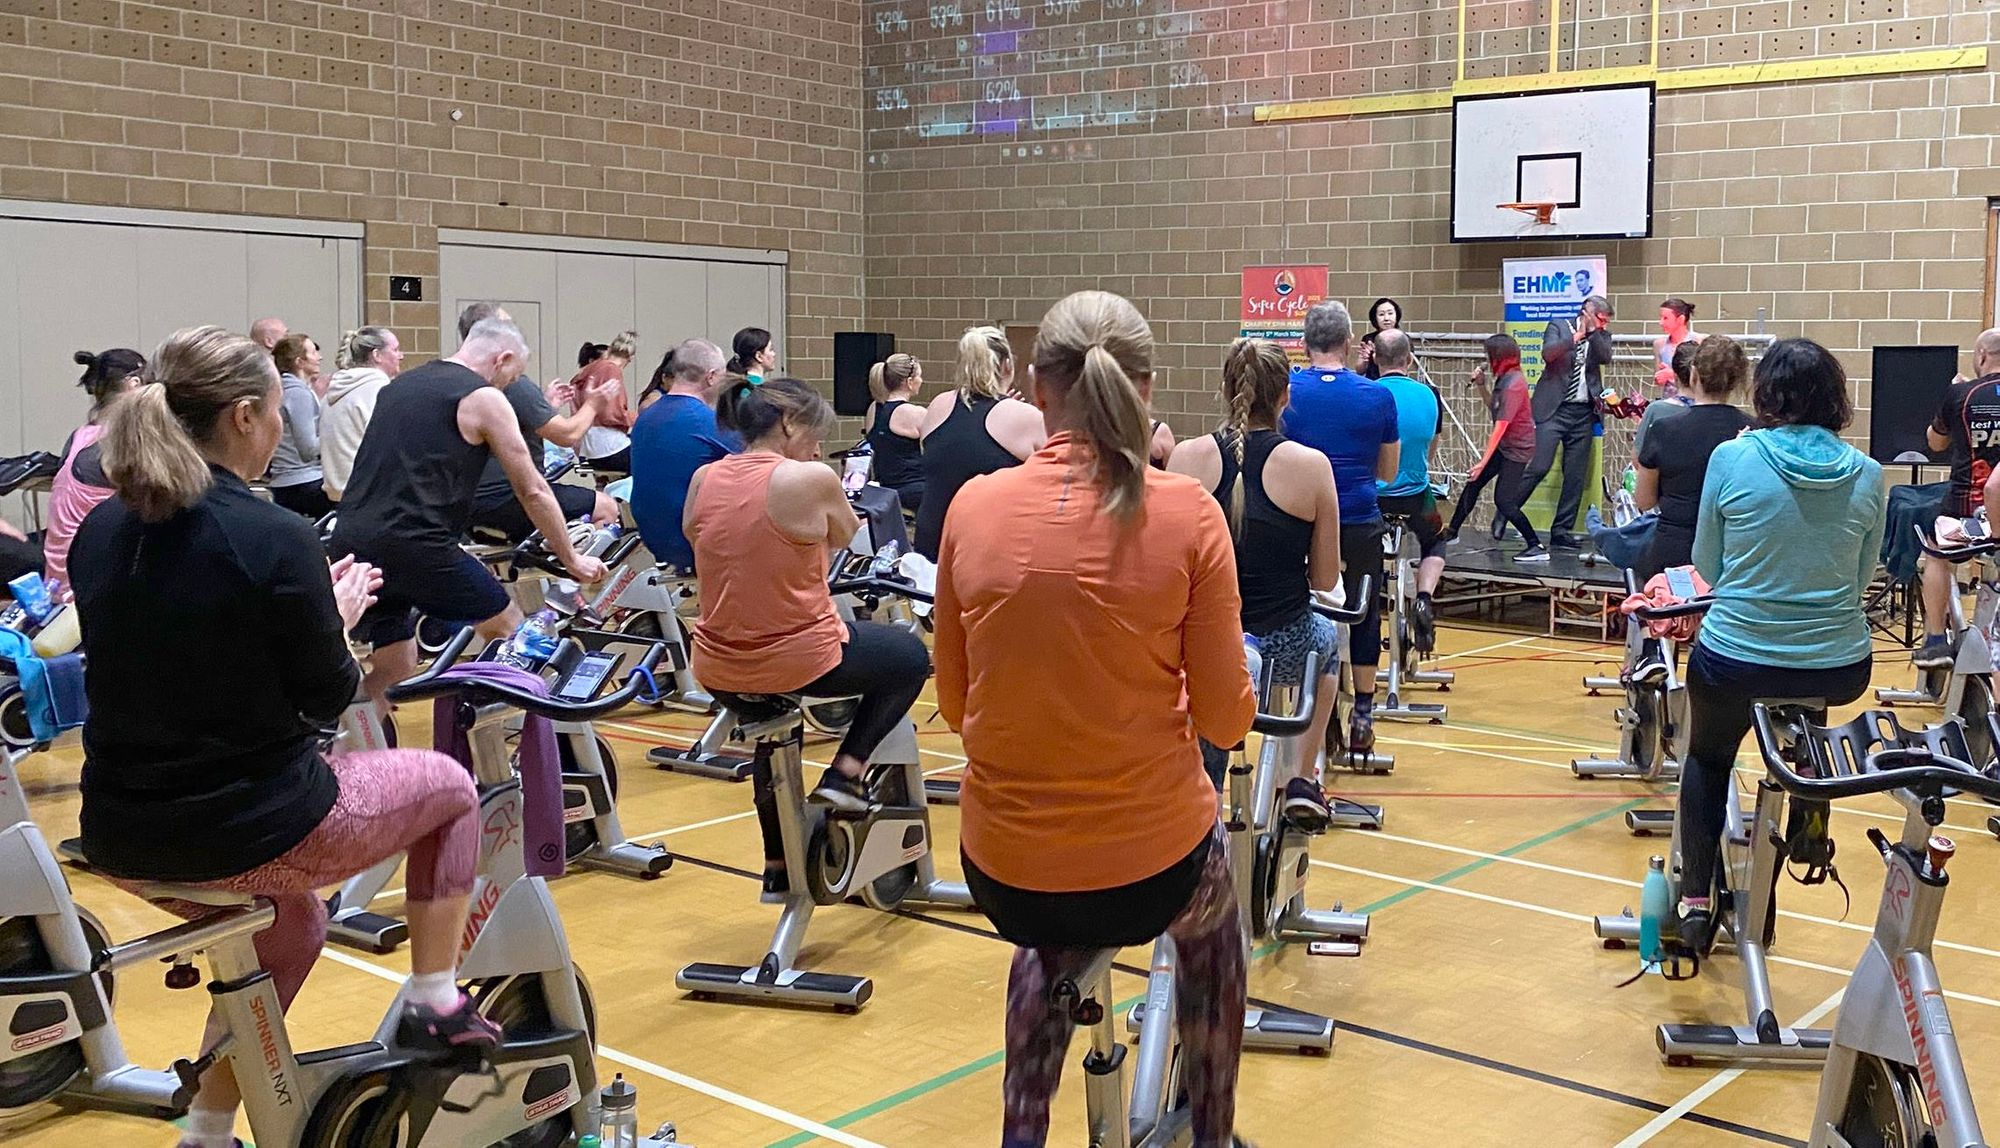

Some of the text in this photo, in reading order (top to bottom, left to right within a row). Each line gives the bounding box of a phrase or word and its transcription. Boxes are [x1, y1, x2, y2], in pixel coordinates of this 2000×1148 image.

[875, 11, 908, 34] 52%
[930, 5, 963, 28] 53%
[985, 80, 1021, 103] 62%
[401, 281, 410, 293] 4
[1513, 273, 1572, 293] EHMF
[1278, 295, 1309, 317] Cycle
[1971, 421, 1992, 429] Lest
[249, 995, 293, 1107] SPINNER NXT
[1893, 955, 1947, 1127] SPINNING
